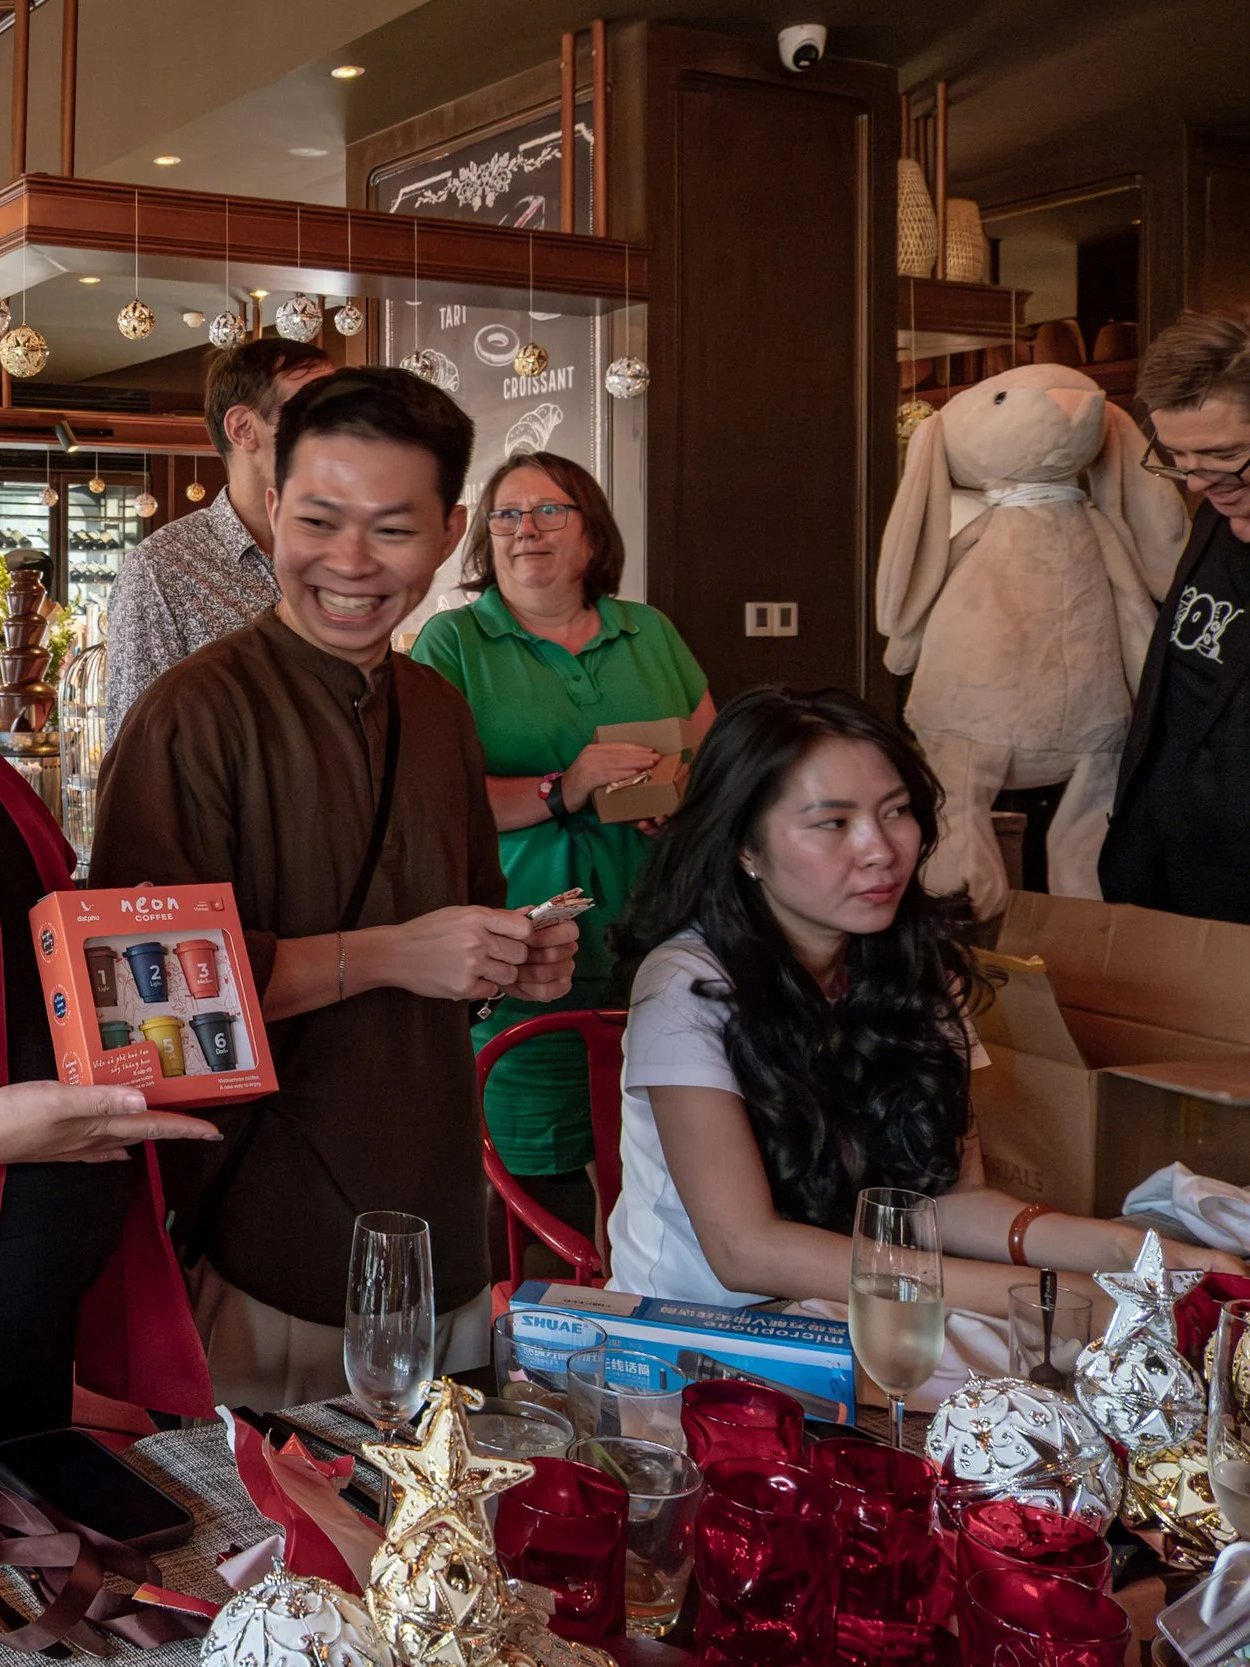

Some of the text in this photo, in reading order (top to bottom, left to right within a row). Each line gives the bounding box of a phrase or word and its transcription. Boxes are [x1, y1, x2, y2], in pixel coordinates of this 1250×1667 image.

[503, 367, 575, 400] CROISSANT
[121, 896, 179, 913] neon
[135, 913, 173, 922] COFFEE
[97, 970, 107, 985] 1
[149, 965, 161, 980] 2
[197, 962, 209, 978] 3
[162, 1038, 174, 1053] 5
[214, 1032, 226, 1049] 6
[521, 1315, 583, 1334] SHUAE
[703, 1321, 844, 1344] microphone
